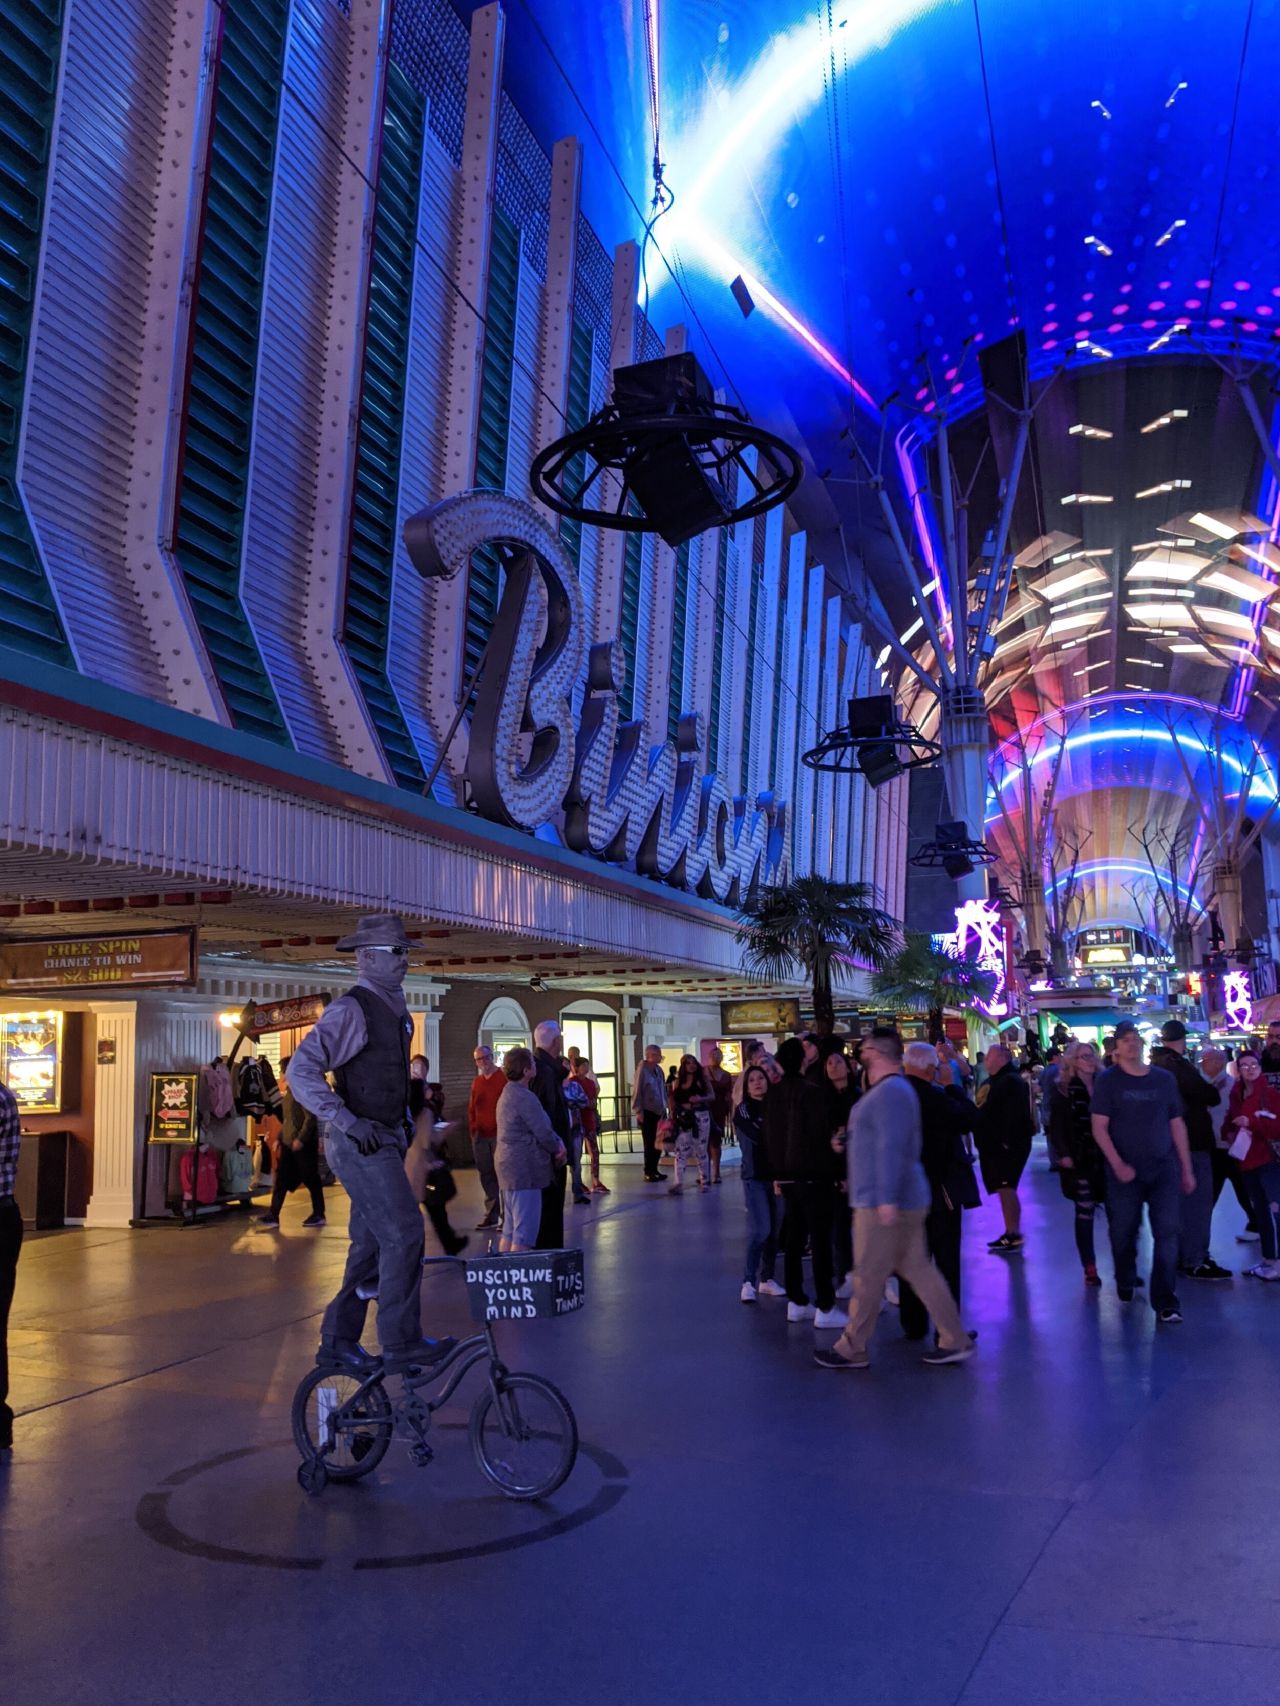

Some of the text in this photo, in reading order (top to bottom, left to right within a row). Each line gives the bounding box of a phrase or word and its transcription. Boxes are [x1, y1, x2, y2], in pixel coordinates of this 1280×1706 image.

[47, 940, 140, 956] FREE SPIN
[44, 954, 142, 969] CHANCE TO WIN
[466, 1269, 552, 1284] DISCIPLINE
[556, 1272, 583, 1292] TIPS
[485, 1287, 534, 1304] YOUR
[486, 1304, 536, 1320] MIND
